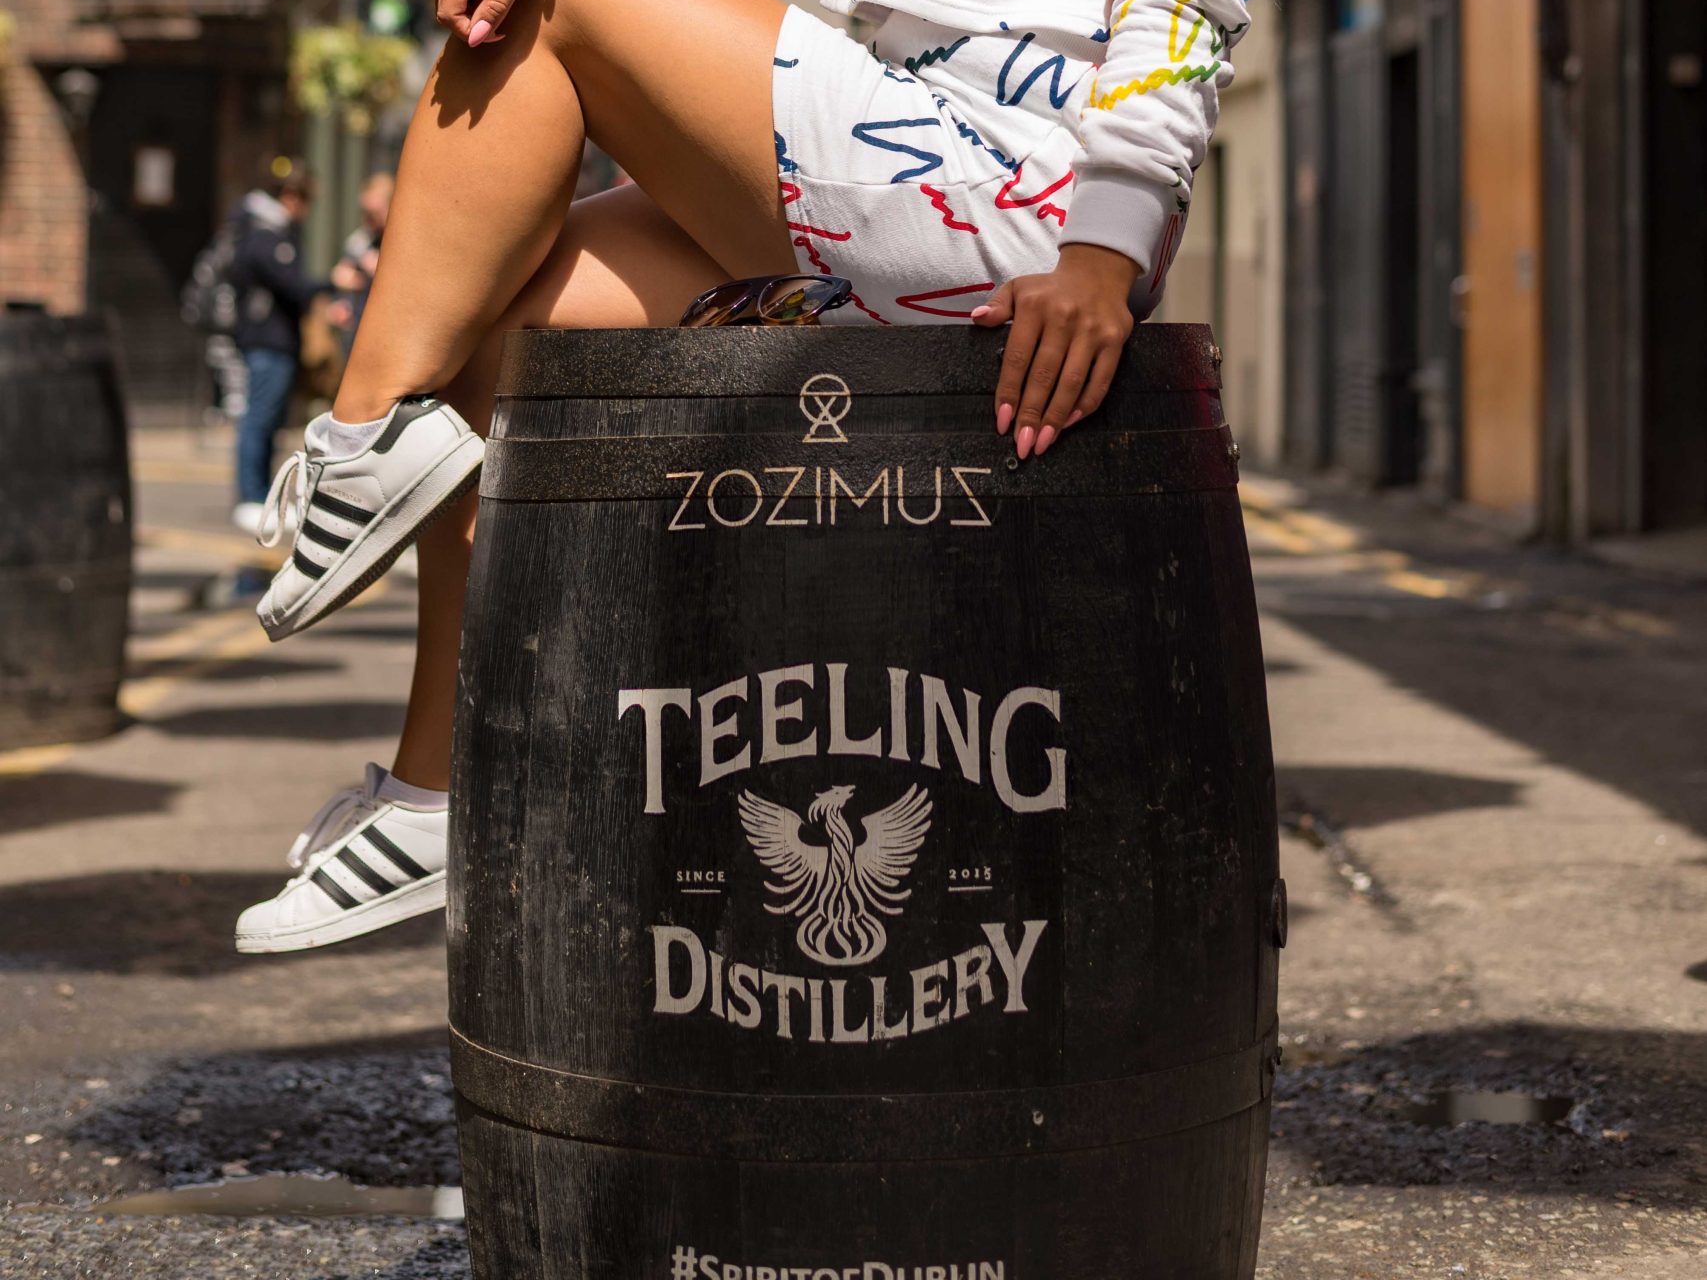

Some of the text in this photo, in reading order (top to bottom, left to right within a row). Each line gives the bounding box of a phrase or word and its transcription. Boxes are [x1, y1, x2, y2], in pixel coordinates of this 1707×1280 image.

[666, 466, 992, 531] ZOZIMUS
[618, 663, 1067, 813] TEELING
[676, 866, 991, 882] SINCE 2015
